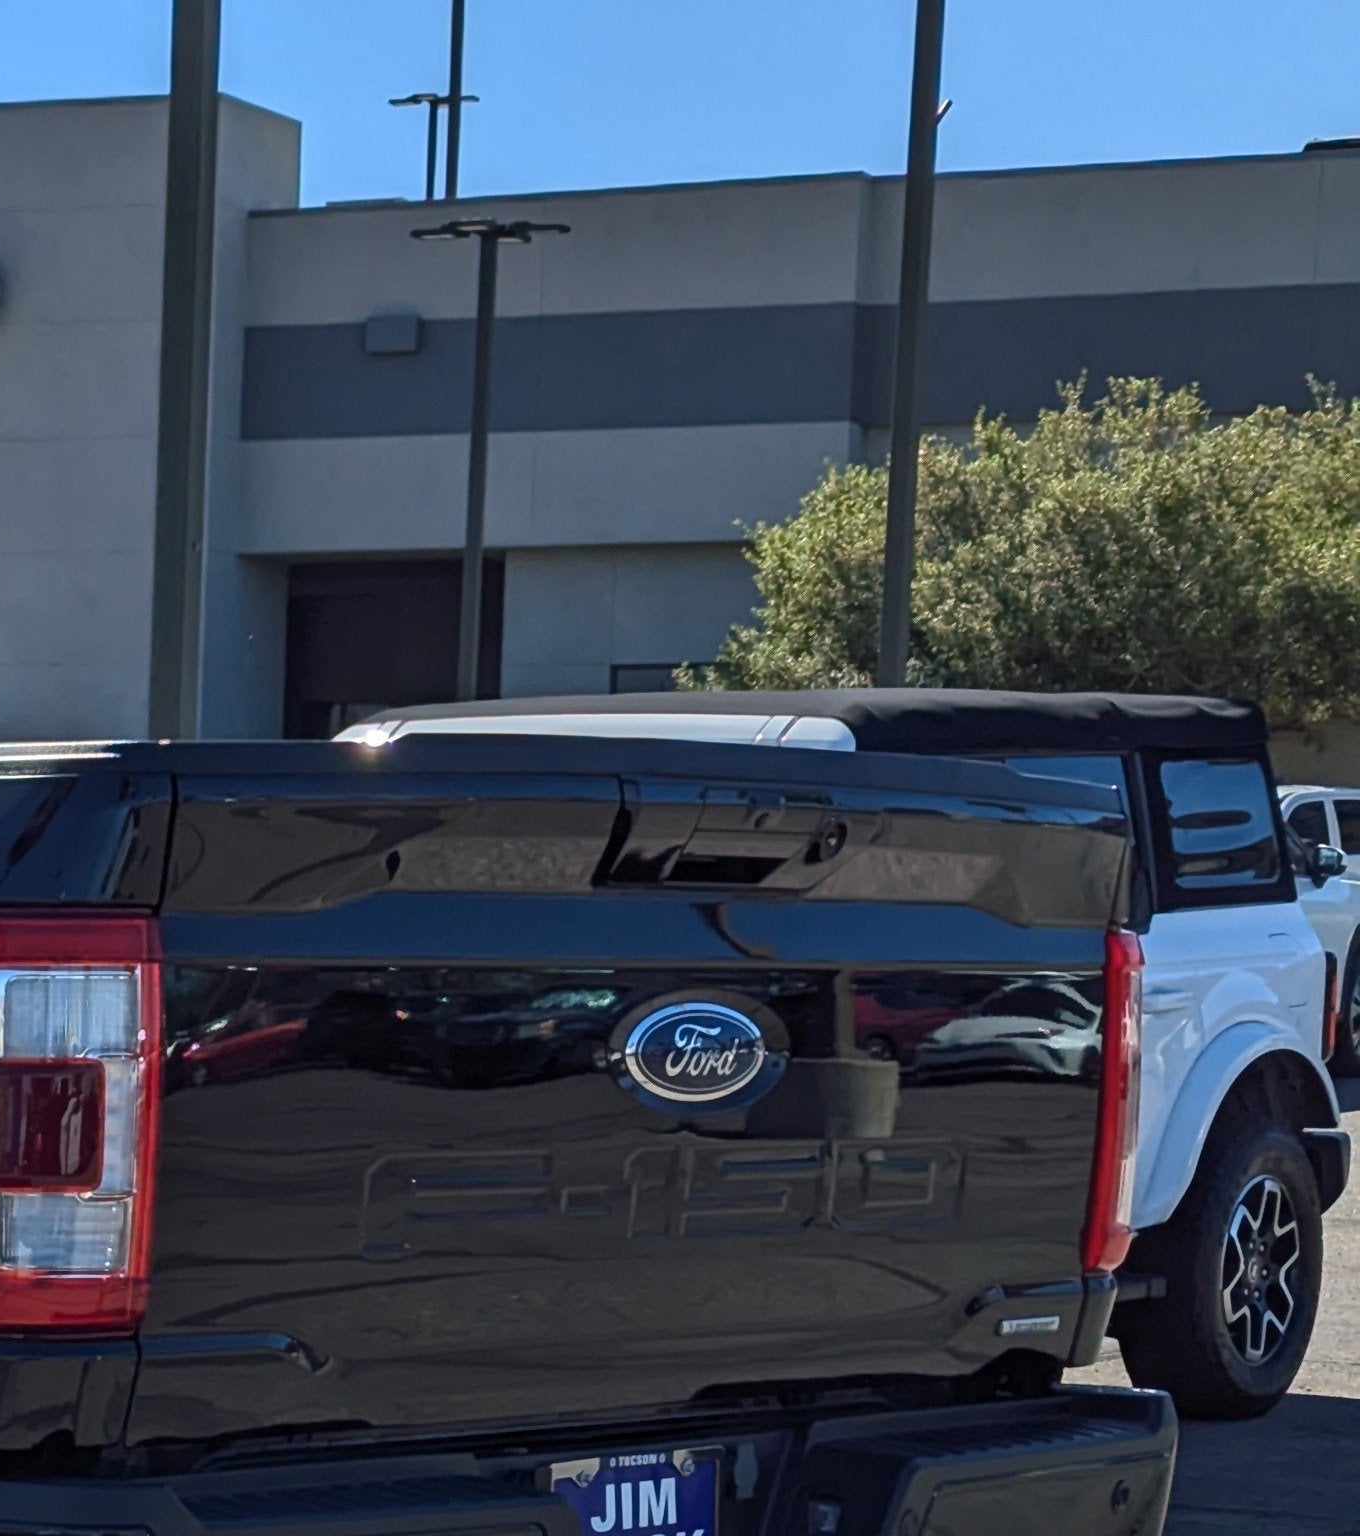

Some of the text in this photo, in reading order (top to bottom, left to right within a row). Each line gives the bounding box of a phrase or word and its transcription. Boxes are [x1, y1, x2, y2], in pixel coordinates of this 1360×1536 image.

[665, 1023, 738, 1077] Ford
[360, 1138, 965, 1258] F-150
[618, 1453, 658, 1467] TUCSON
[590, 1477, 677, 1533] JIM
